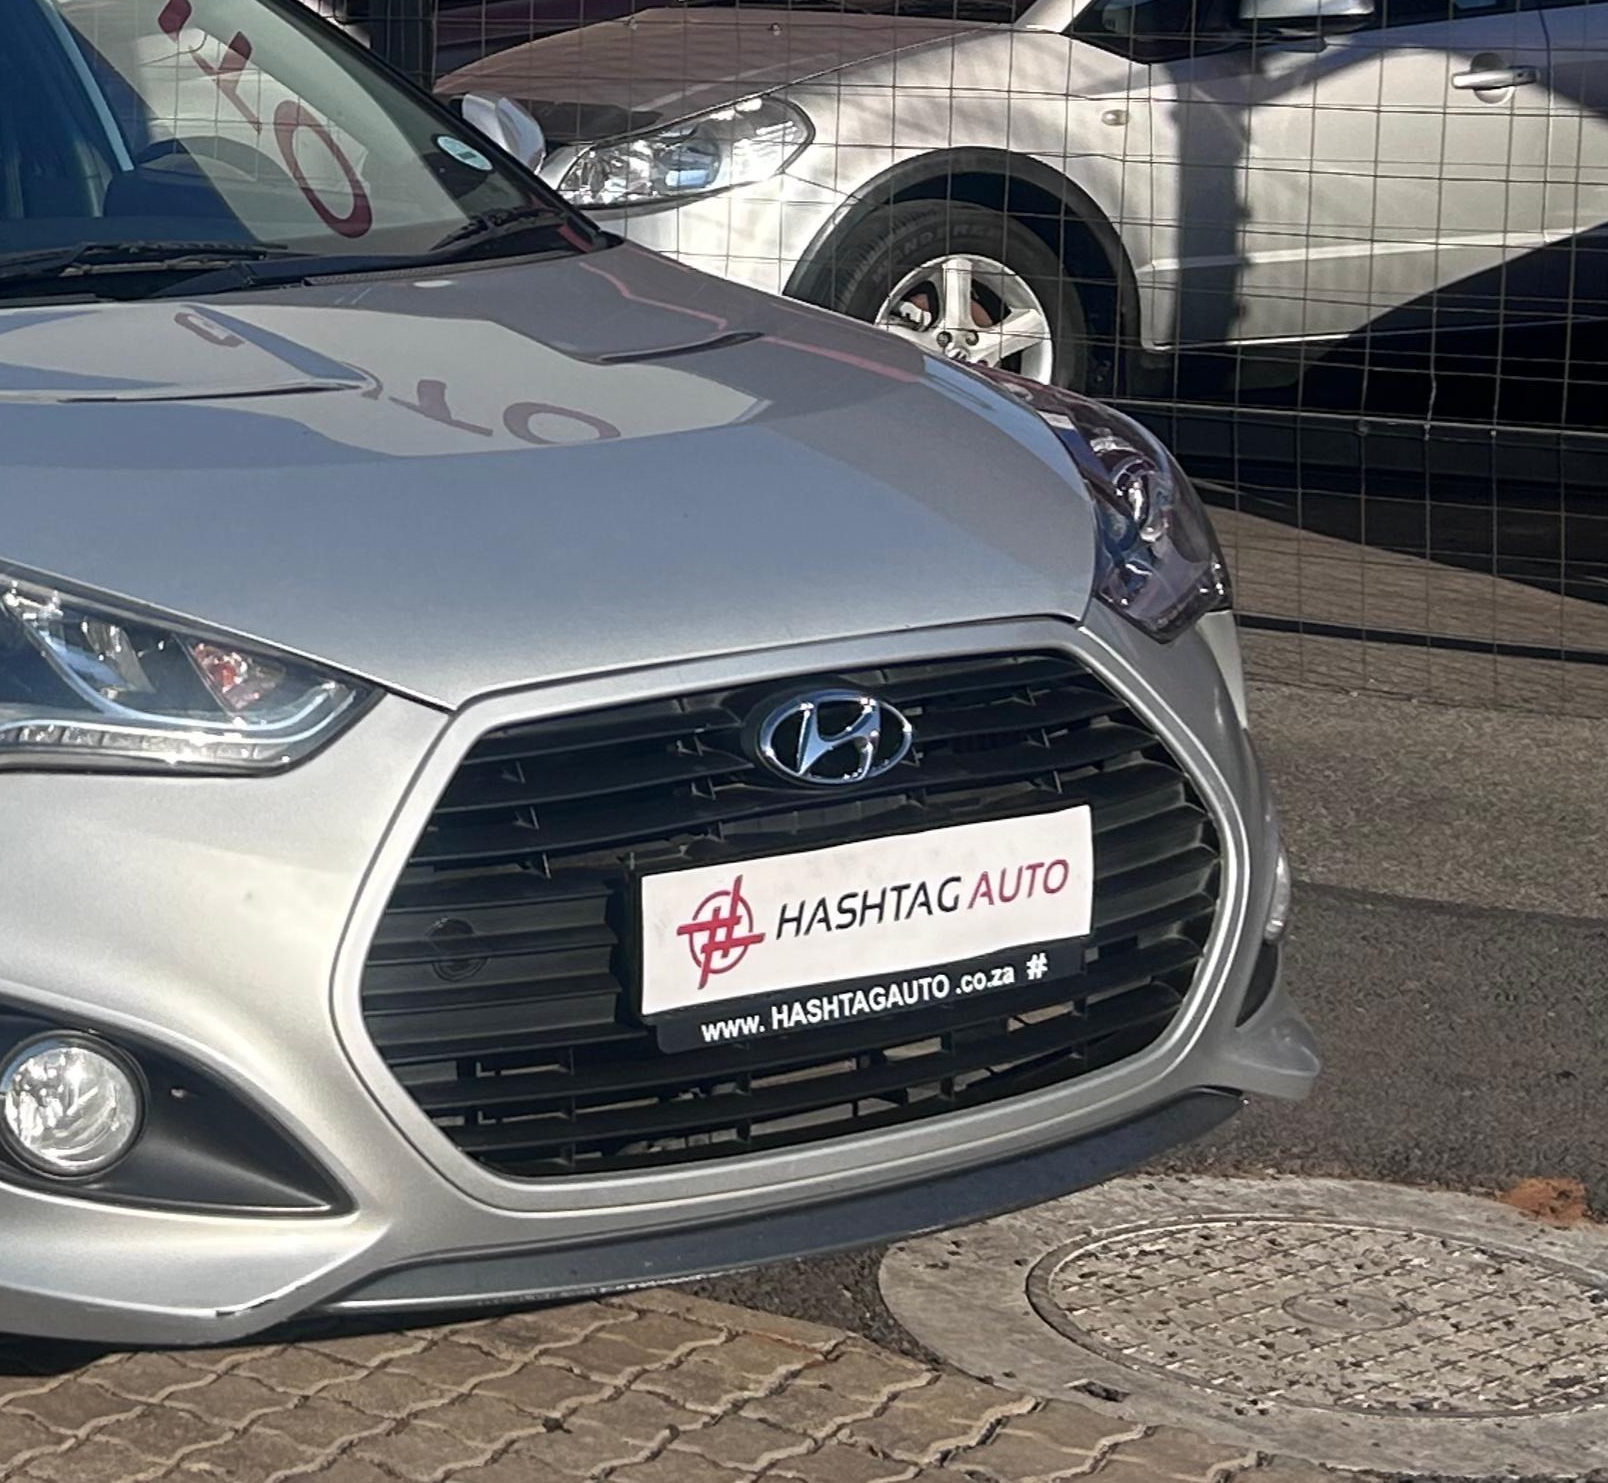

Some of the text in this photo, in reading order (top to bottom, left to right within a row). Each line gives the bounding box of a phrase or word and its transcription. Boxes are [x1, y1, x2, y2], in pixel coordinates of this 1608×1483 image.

[775, 858, 1070, 941] HASHTAG AUTO
[700, 1014, 766, 1043] www.
[770, 973, 951, 1030] HASHTAGAUTO
[955, 965, 1016, 995] .co.za
